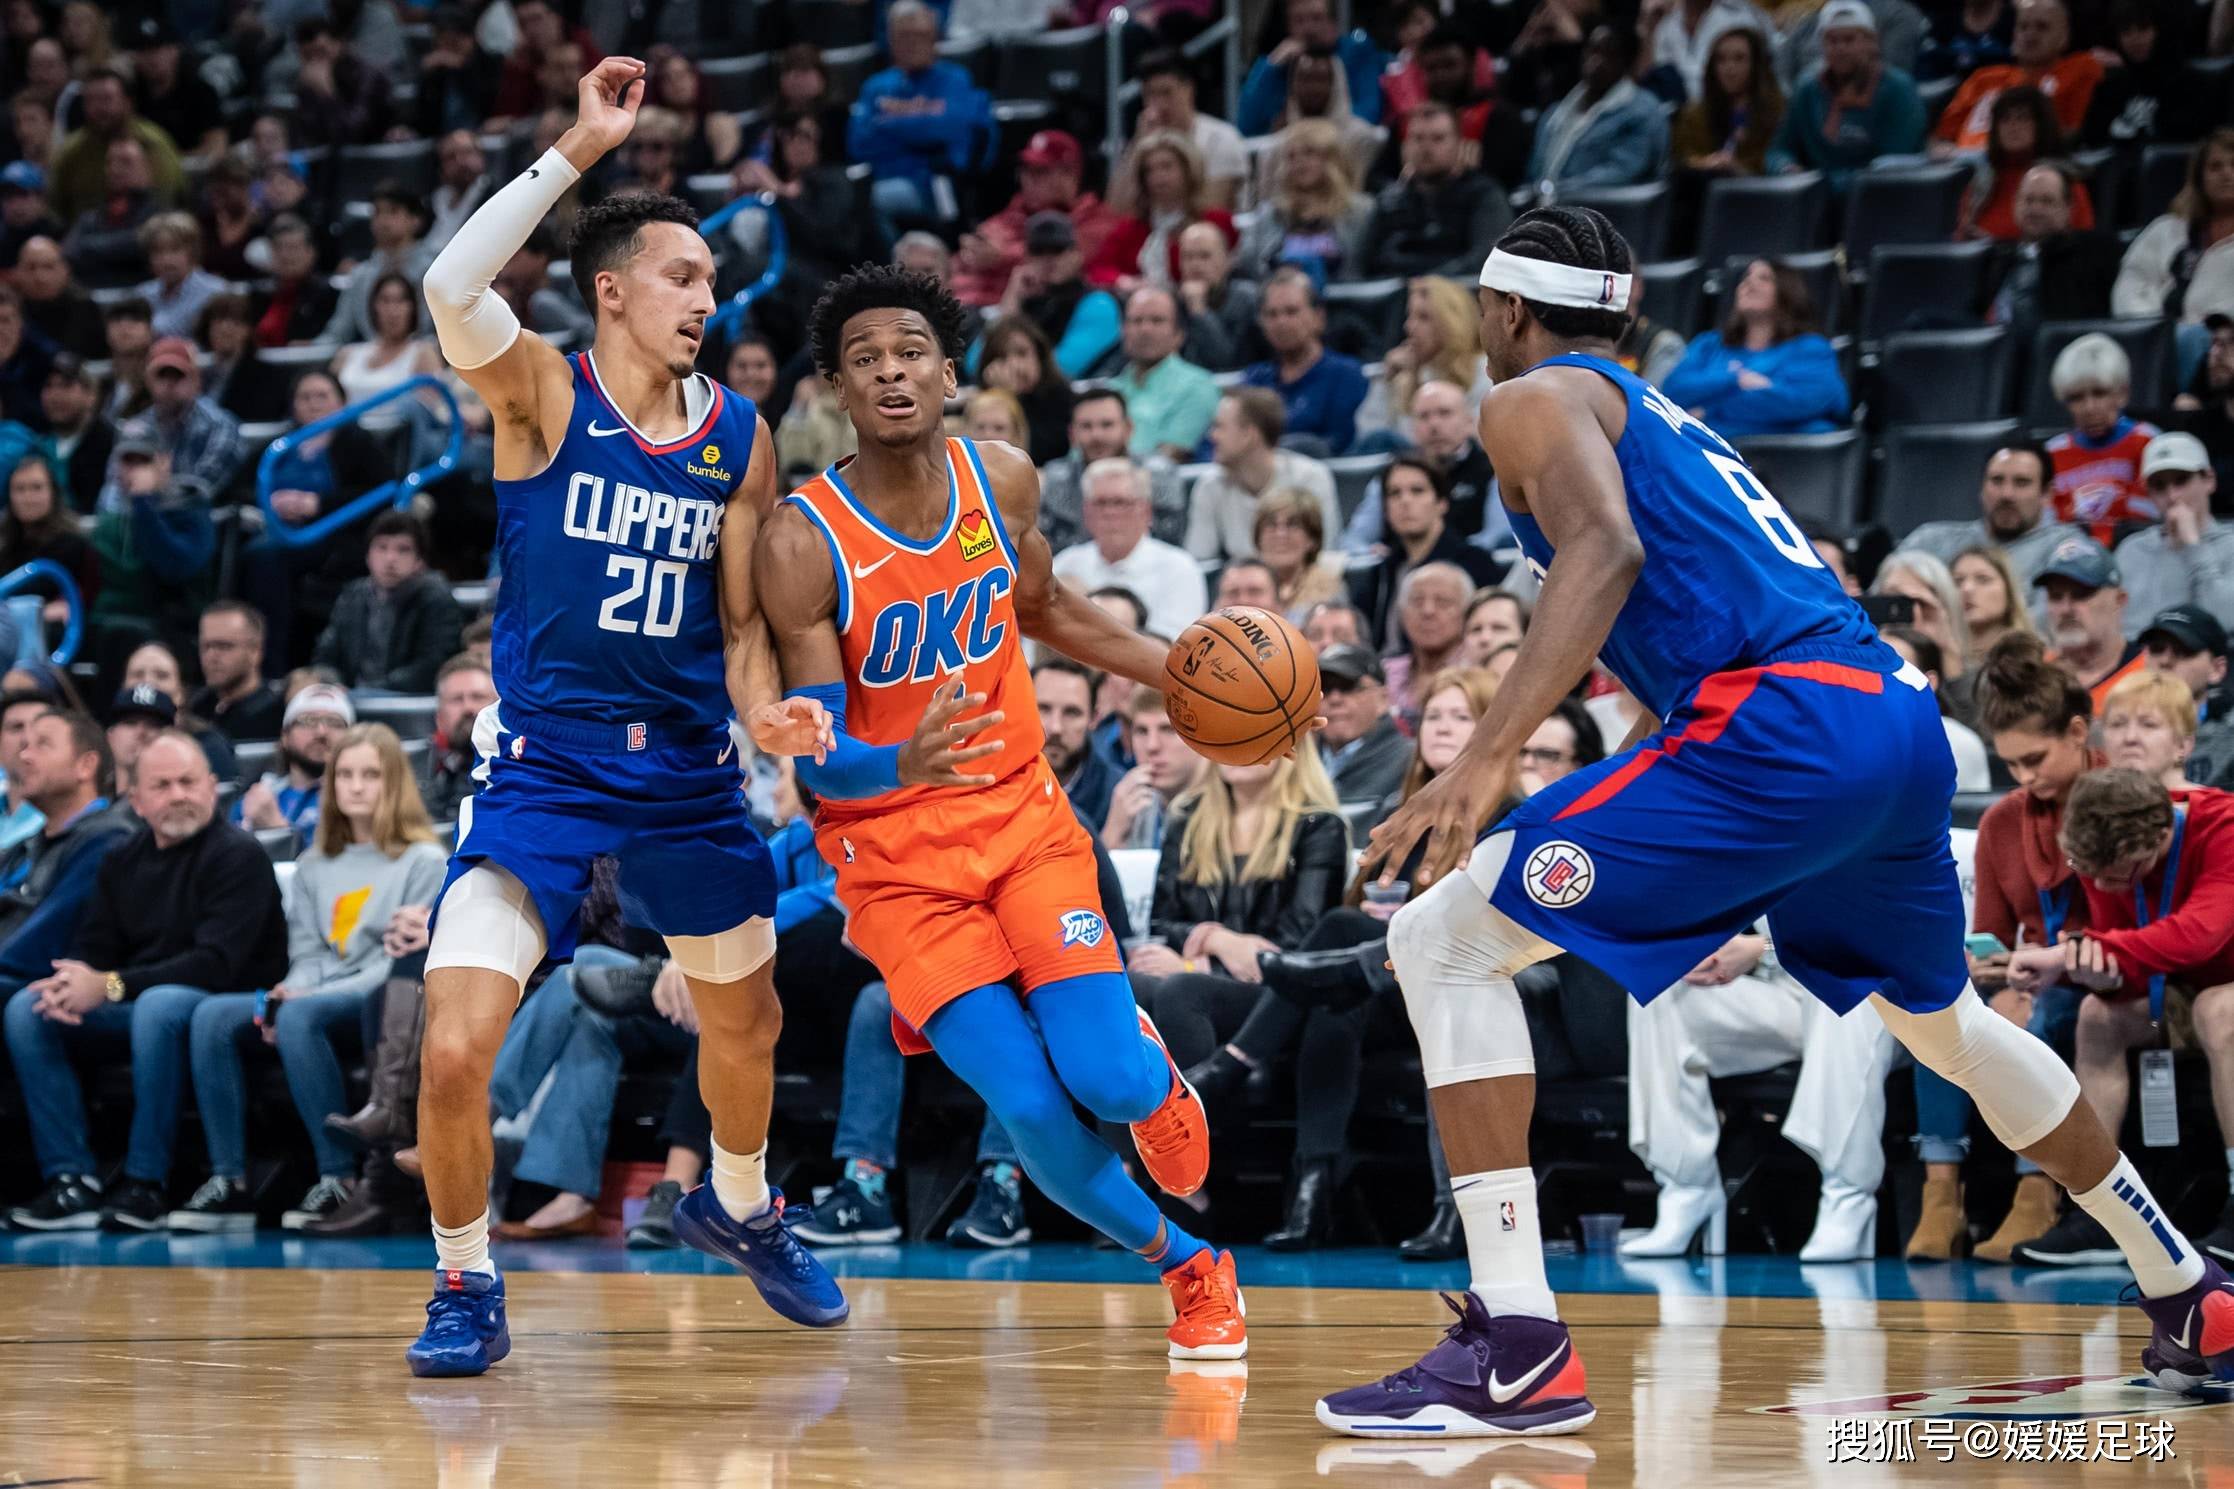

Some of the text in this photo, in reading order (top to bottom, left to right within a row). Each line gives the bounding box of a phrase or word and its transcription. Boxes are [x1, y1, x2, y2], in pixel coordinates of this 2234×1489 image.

[563, 471, 725, 560] CLIPPERS
[687, 461, 731, 481] bumble
[1702, 449, 1825, 569] 8
[598, 553, 689, 638] 20
[859, 565, 1011, 689] OKC
